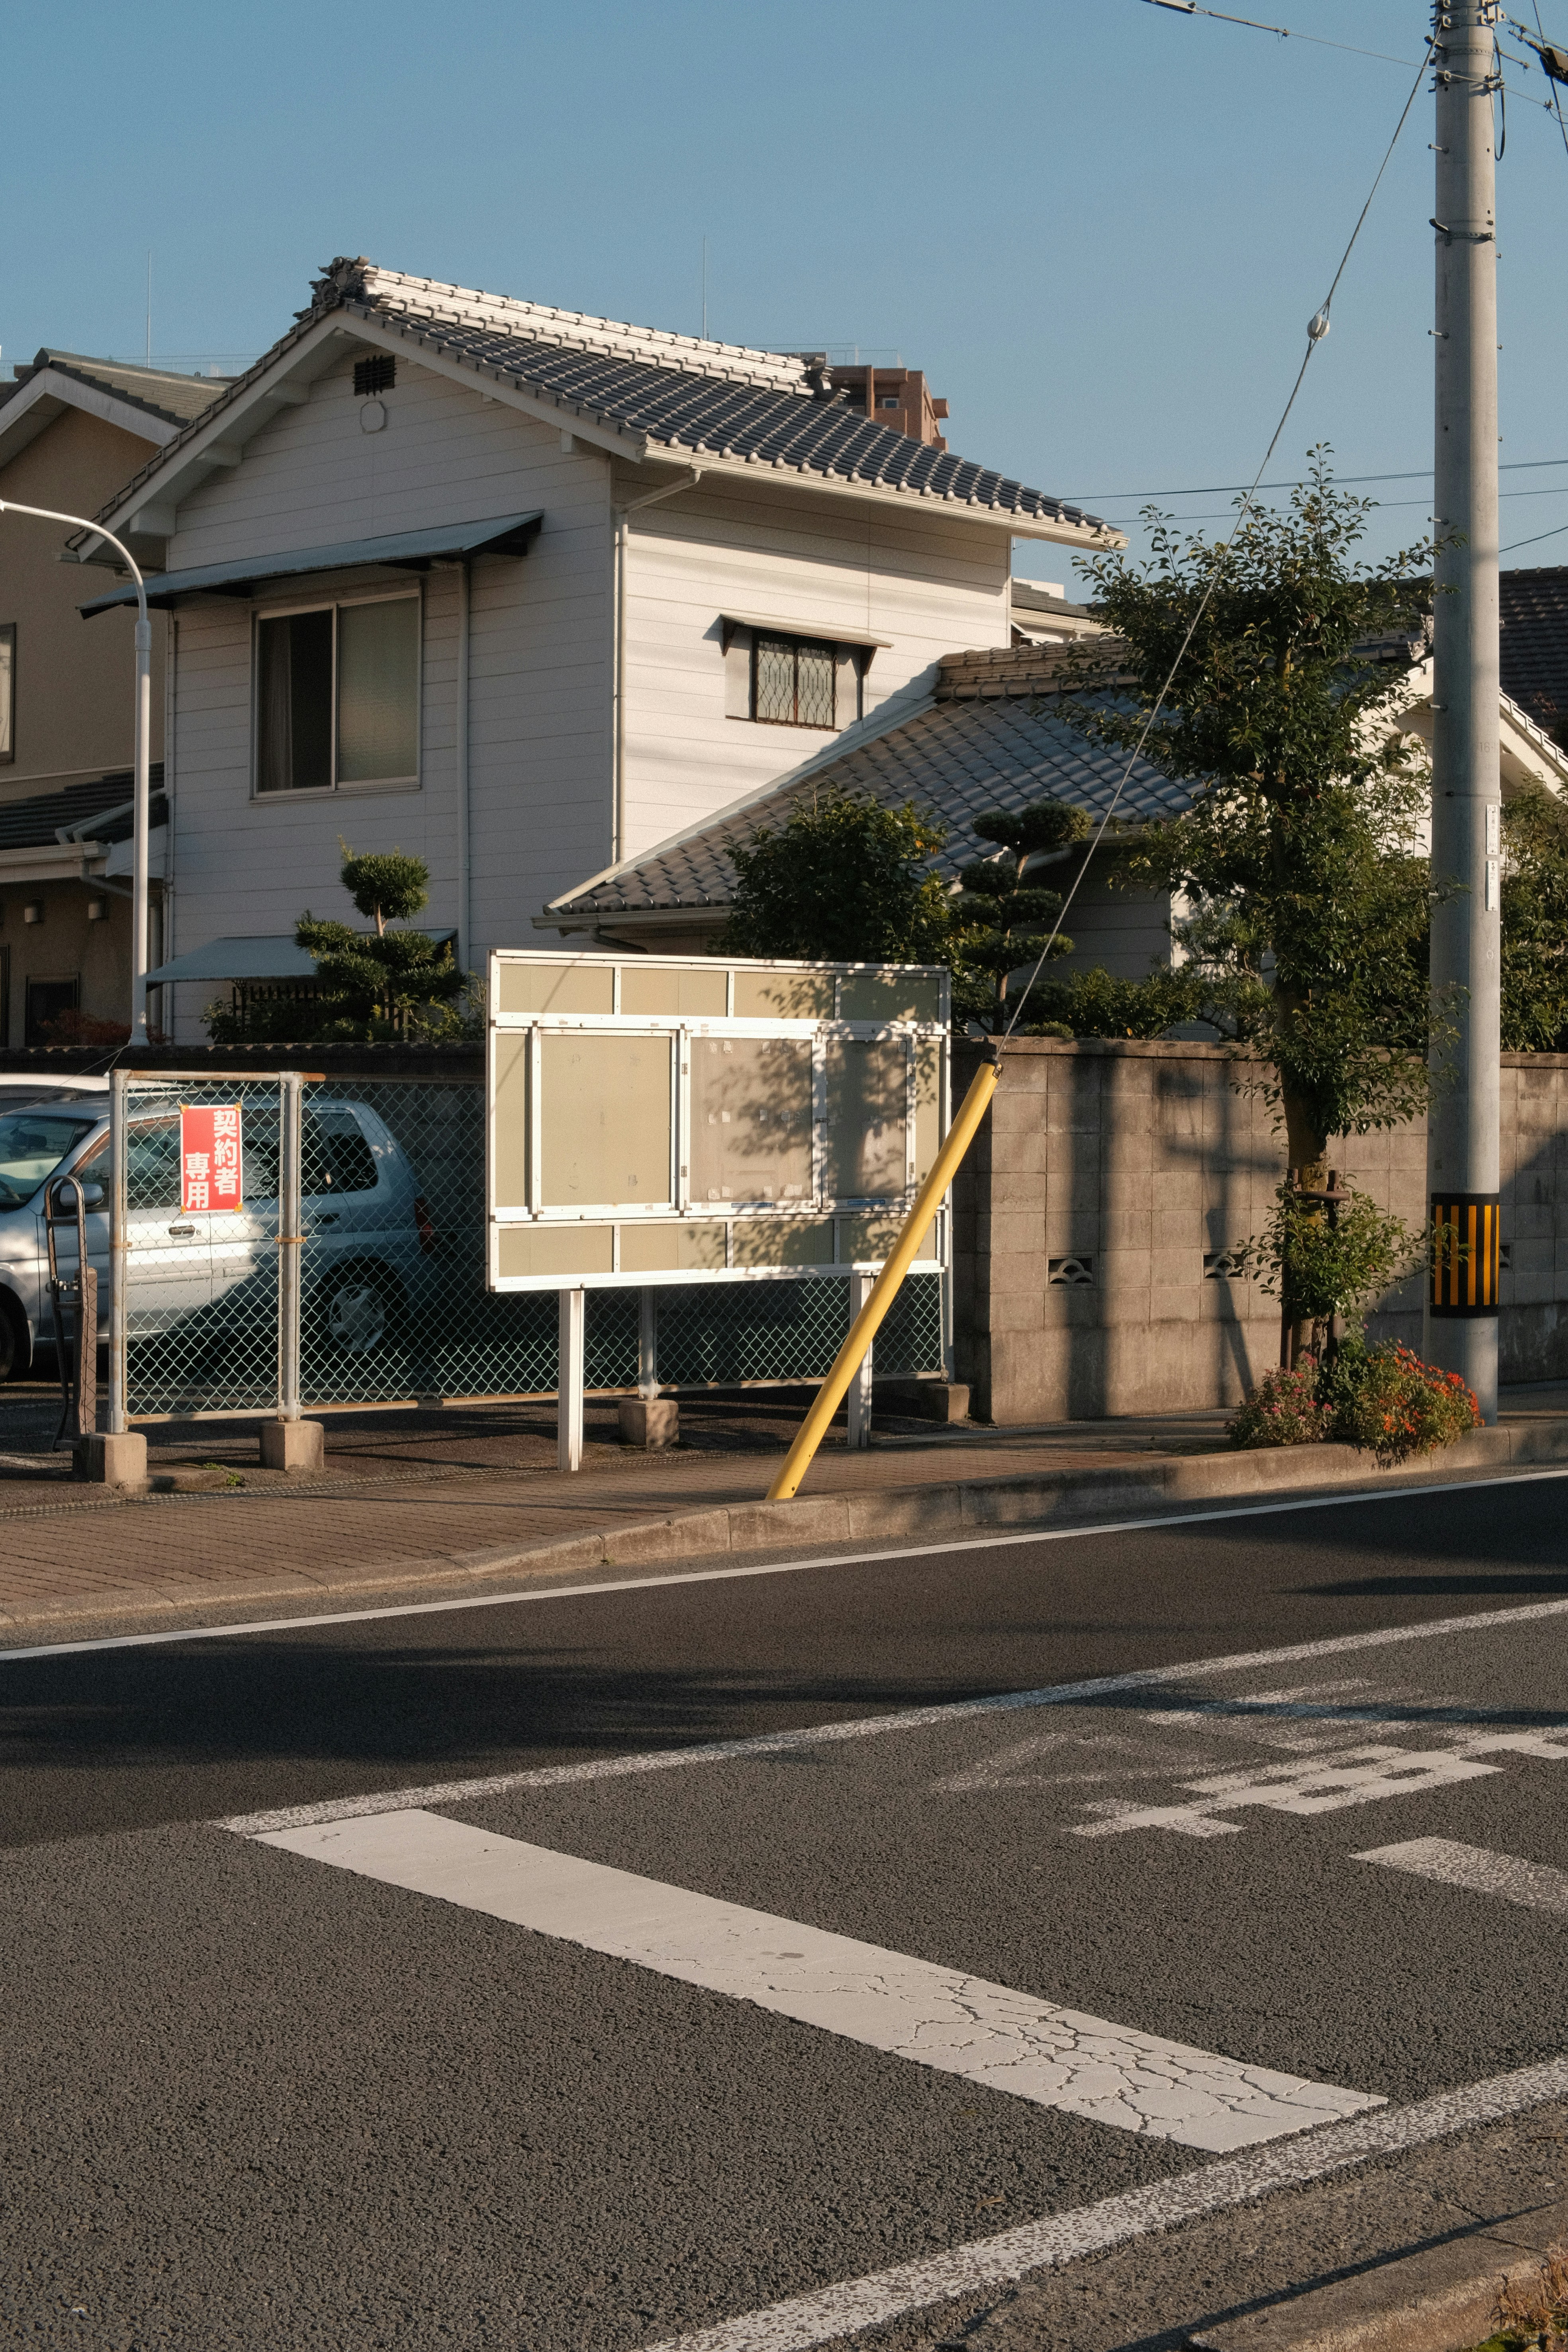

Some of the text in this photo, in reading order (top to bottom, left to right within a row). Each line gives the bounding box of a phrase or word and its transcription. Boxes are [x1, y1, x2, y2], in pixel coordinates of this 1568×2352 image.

[185, 1152, 210, 1209] 専用
[213, 1109, 238, 1195] 契約者
